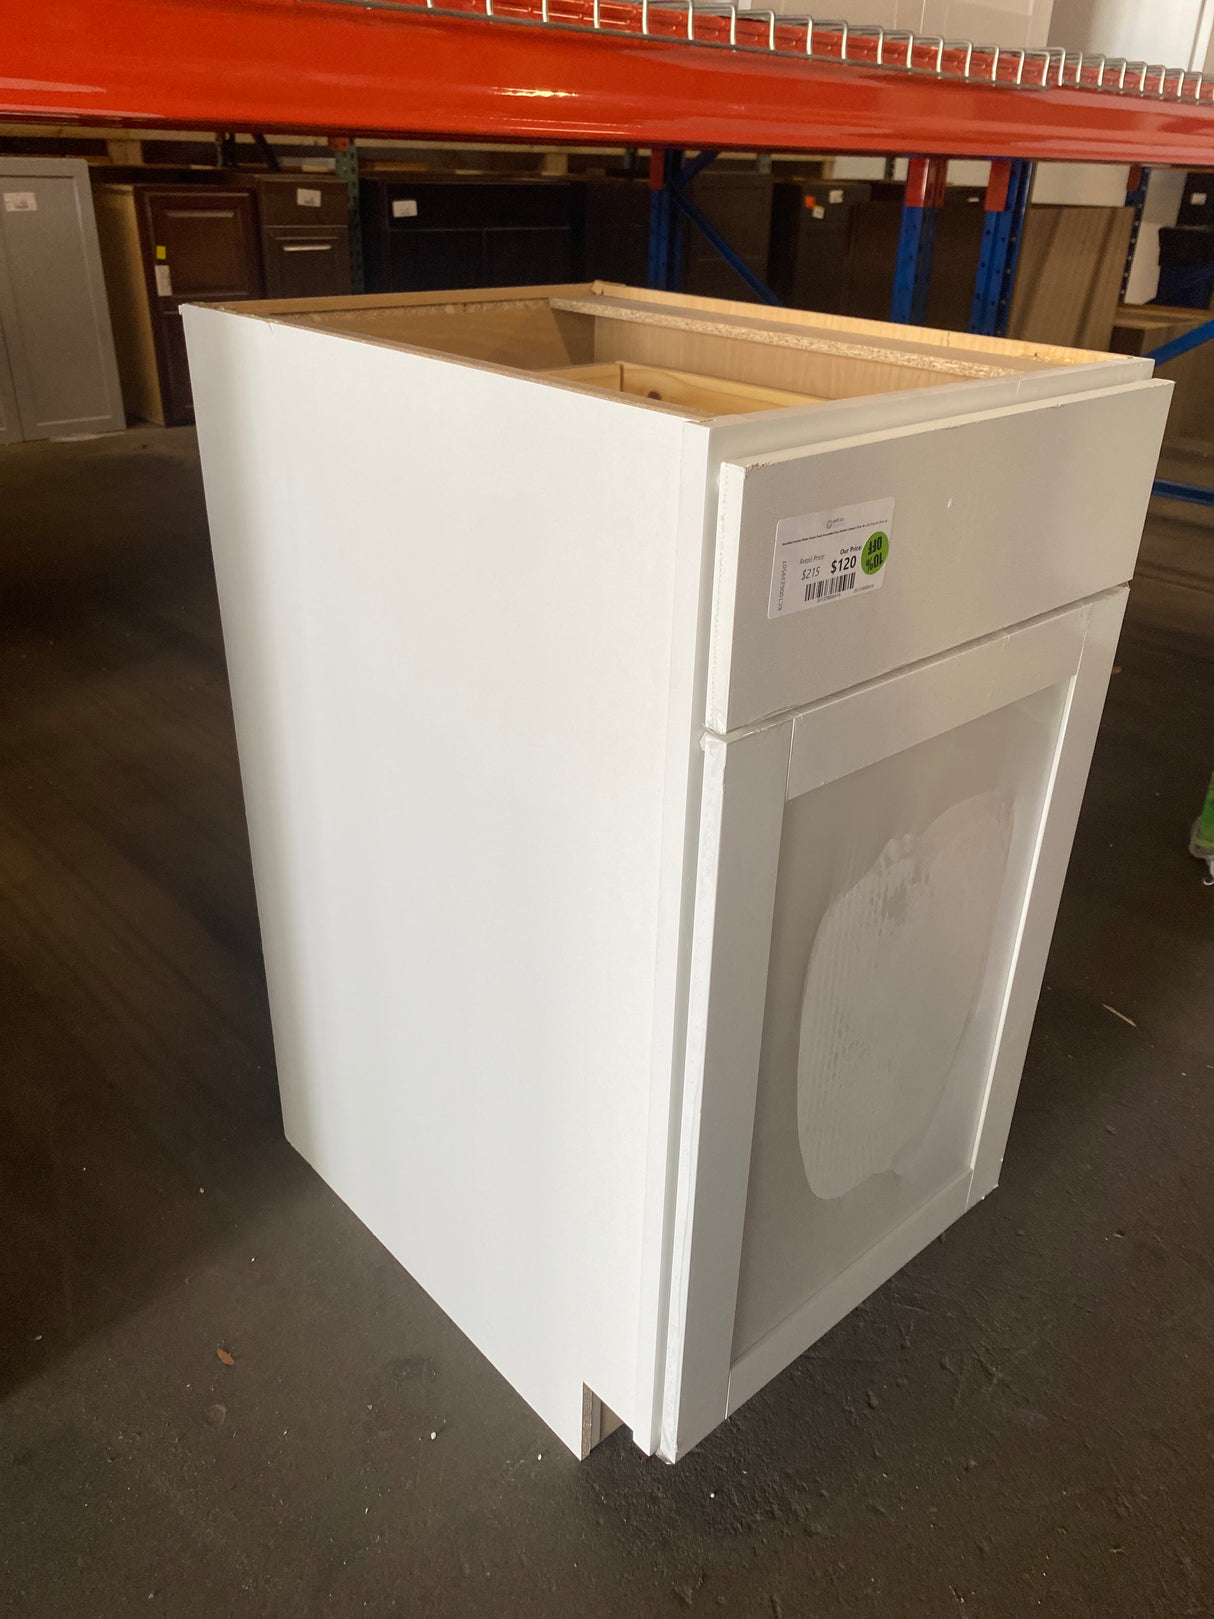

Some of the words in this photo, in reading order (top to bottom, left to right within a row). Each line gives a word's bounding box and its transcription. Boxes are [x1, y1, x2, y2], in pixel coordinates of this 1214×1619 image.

[867, 536, 883, 555] OFF
[831, 556, 857, 574] $120
[866, 554, 883, 572] 10%
[801, 567, 820, 581] $215
